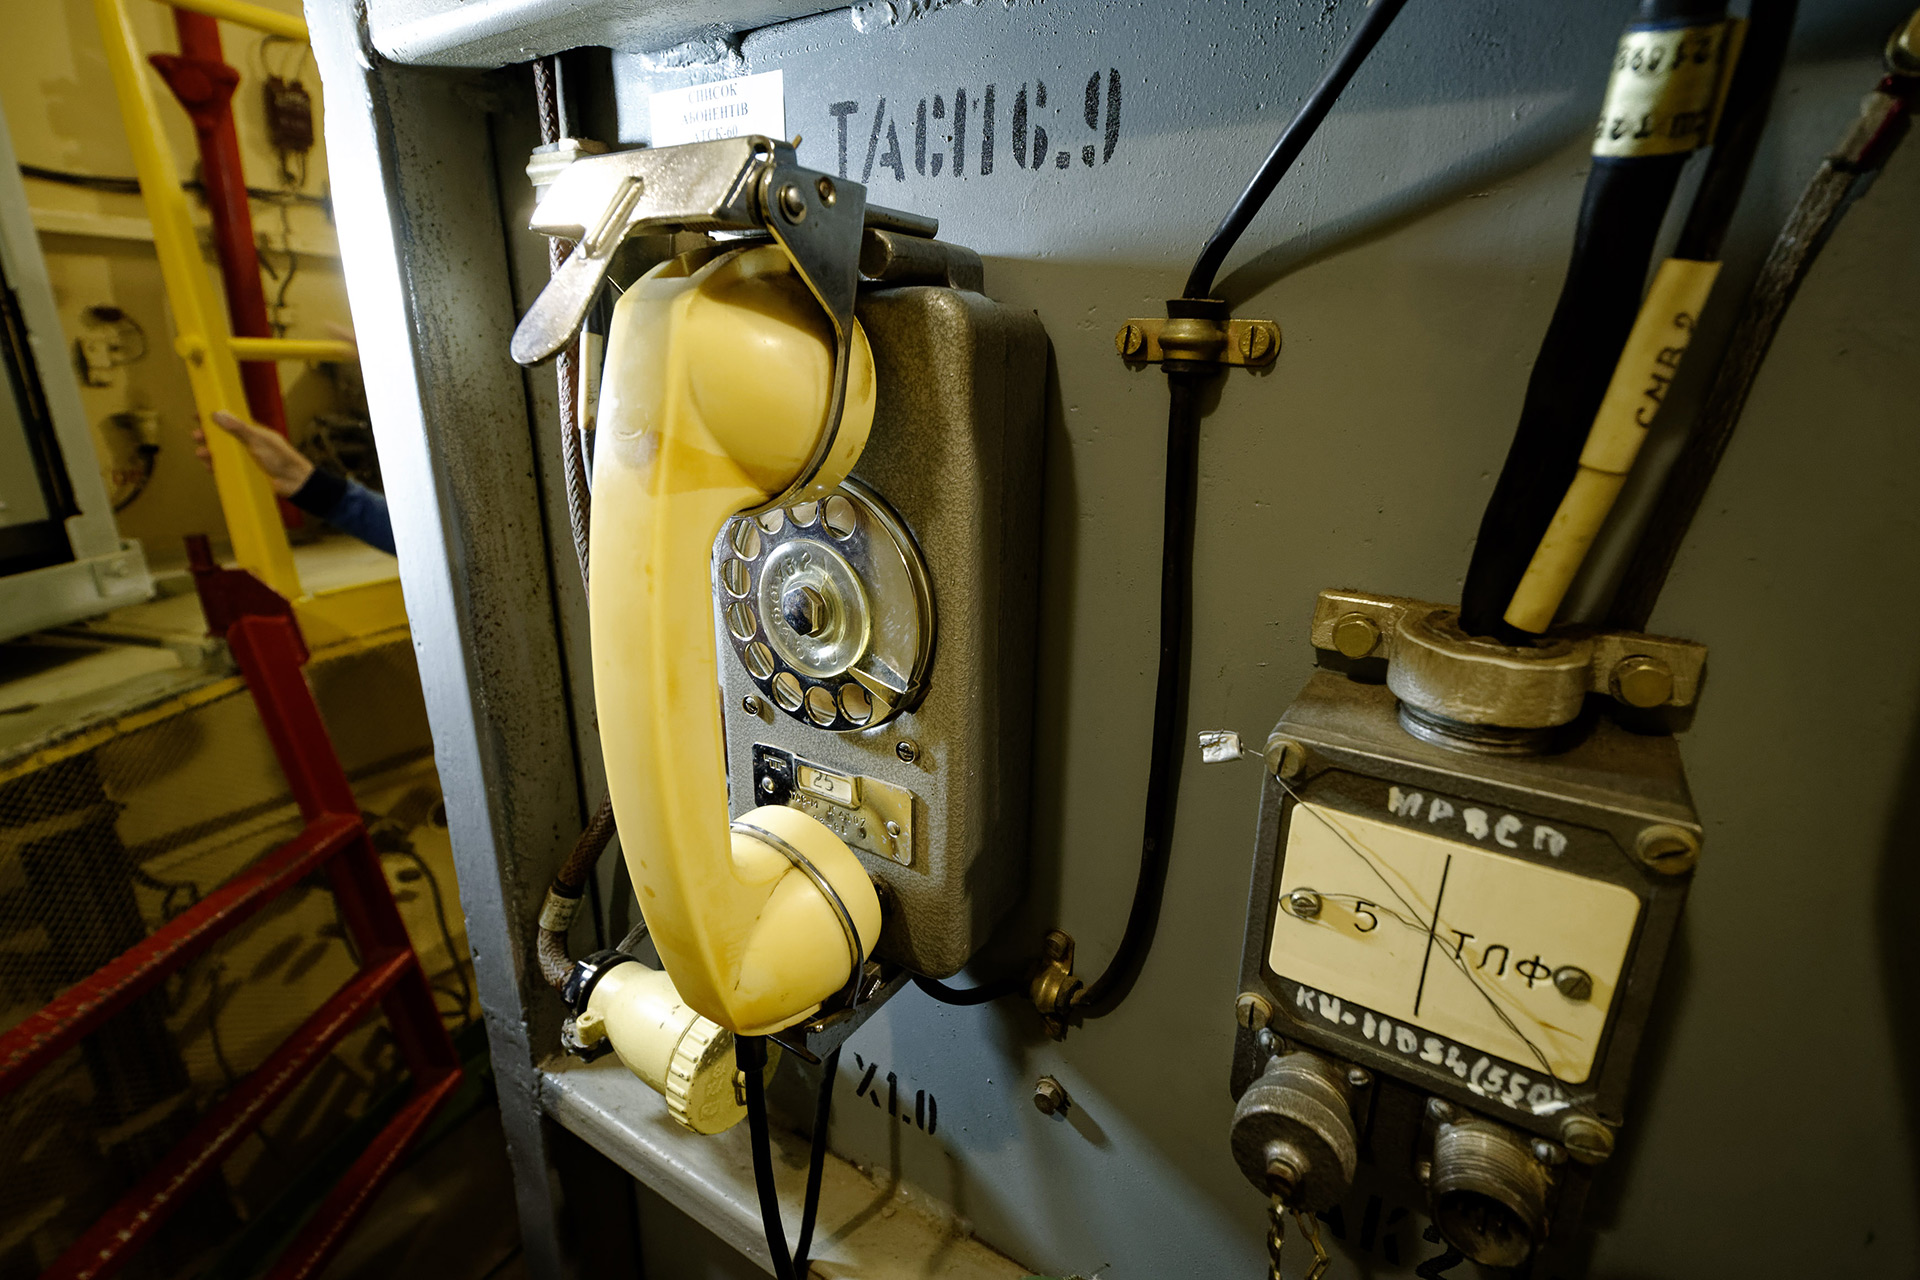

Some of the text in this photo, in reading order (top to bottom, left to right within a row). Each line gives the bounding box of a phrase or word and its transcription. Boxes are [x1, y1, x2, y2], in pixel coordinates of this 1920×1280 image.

[688, 82, 738, 104] СПИСОК
[682, 101, 749, 125] АБОНЕНТІВ
[813, 769, 834, 792] 25
[1354, 900, 1378, 933] 5
[1451, 929, 1552, 989] ТЛФ
